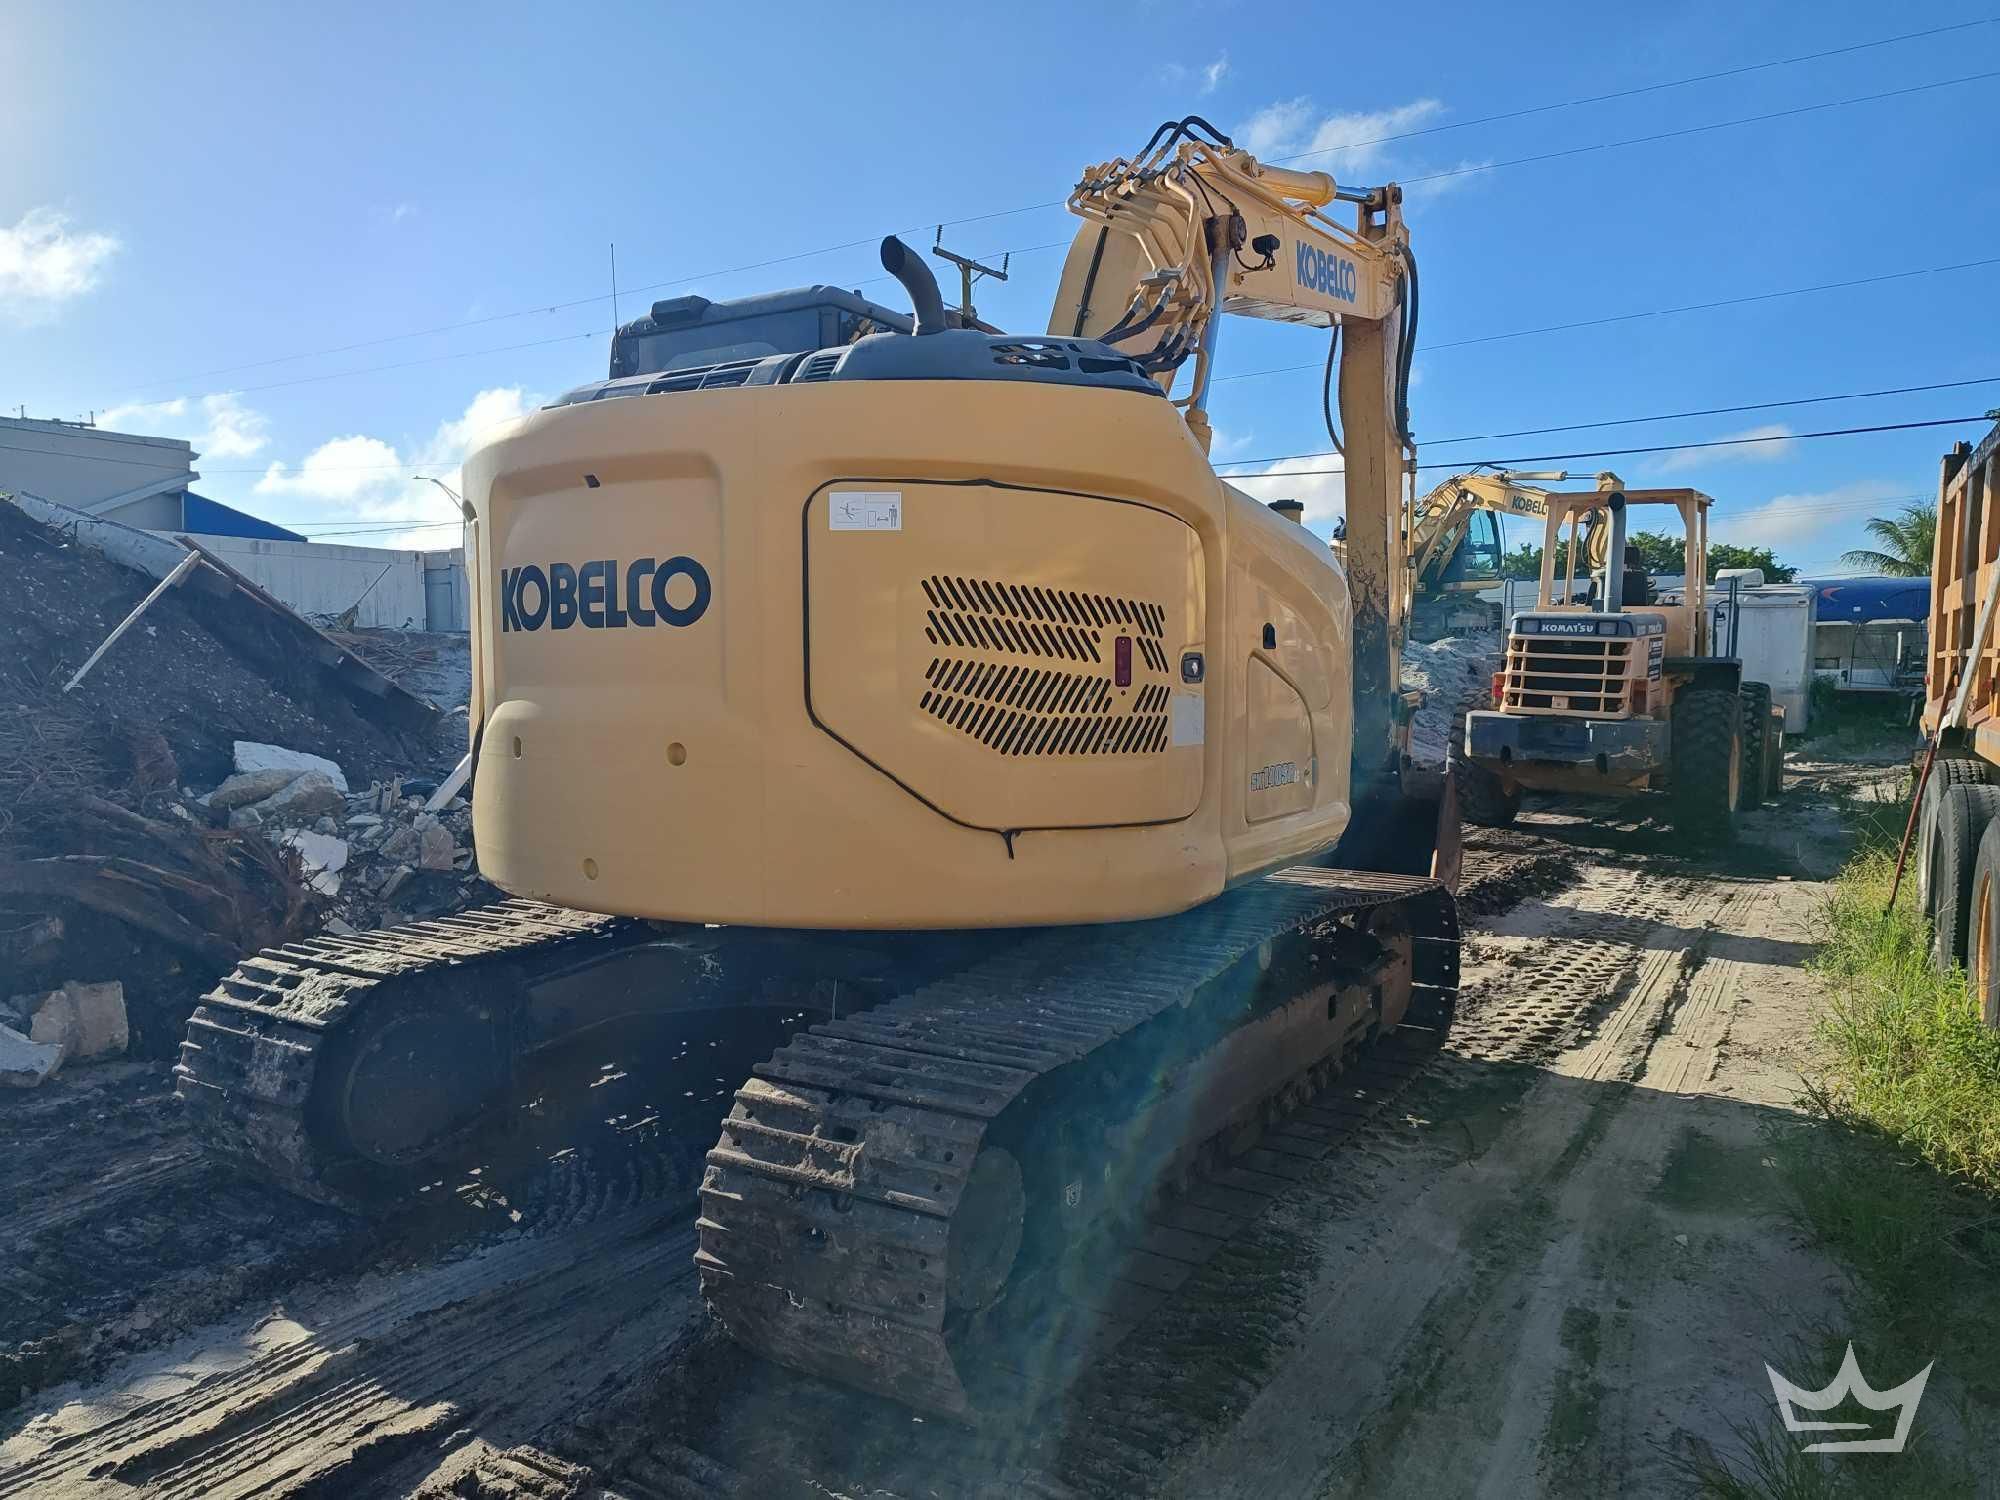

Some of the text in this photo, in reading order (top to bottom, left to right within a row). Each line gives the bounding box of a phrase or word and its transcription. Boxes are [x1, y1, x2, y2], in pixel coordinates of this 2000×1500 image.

[1296, 239, 1355, 303] KOBELCO
[501, 556, 711, 632] KOBELCO
[1541, 623, 1594, 633] KOMATSU
